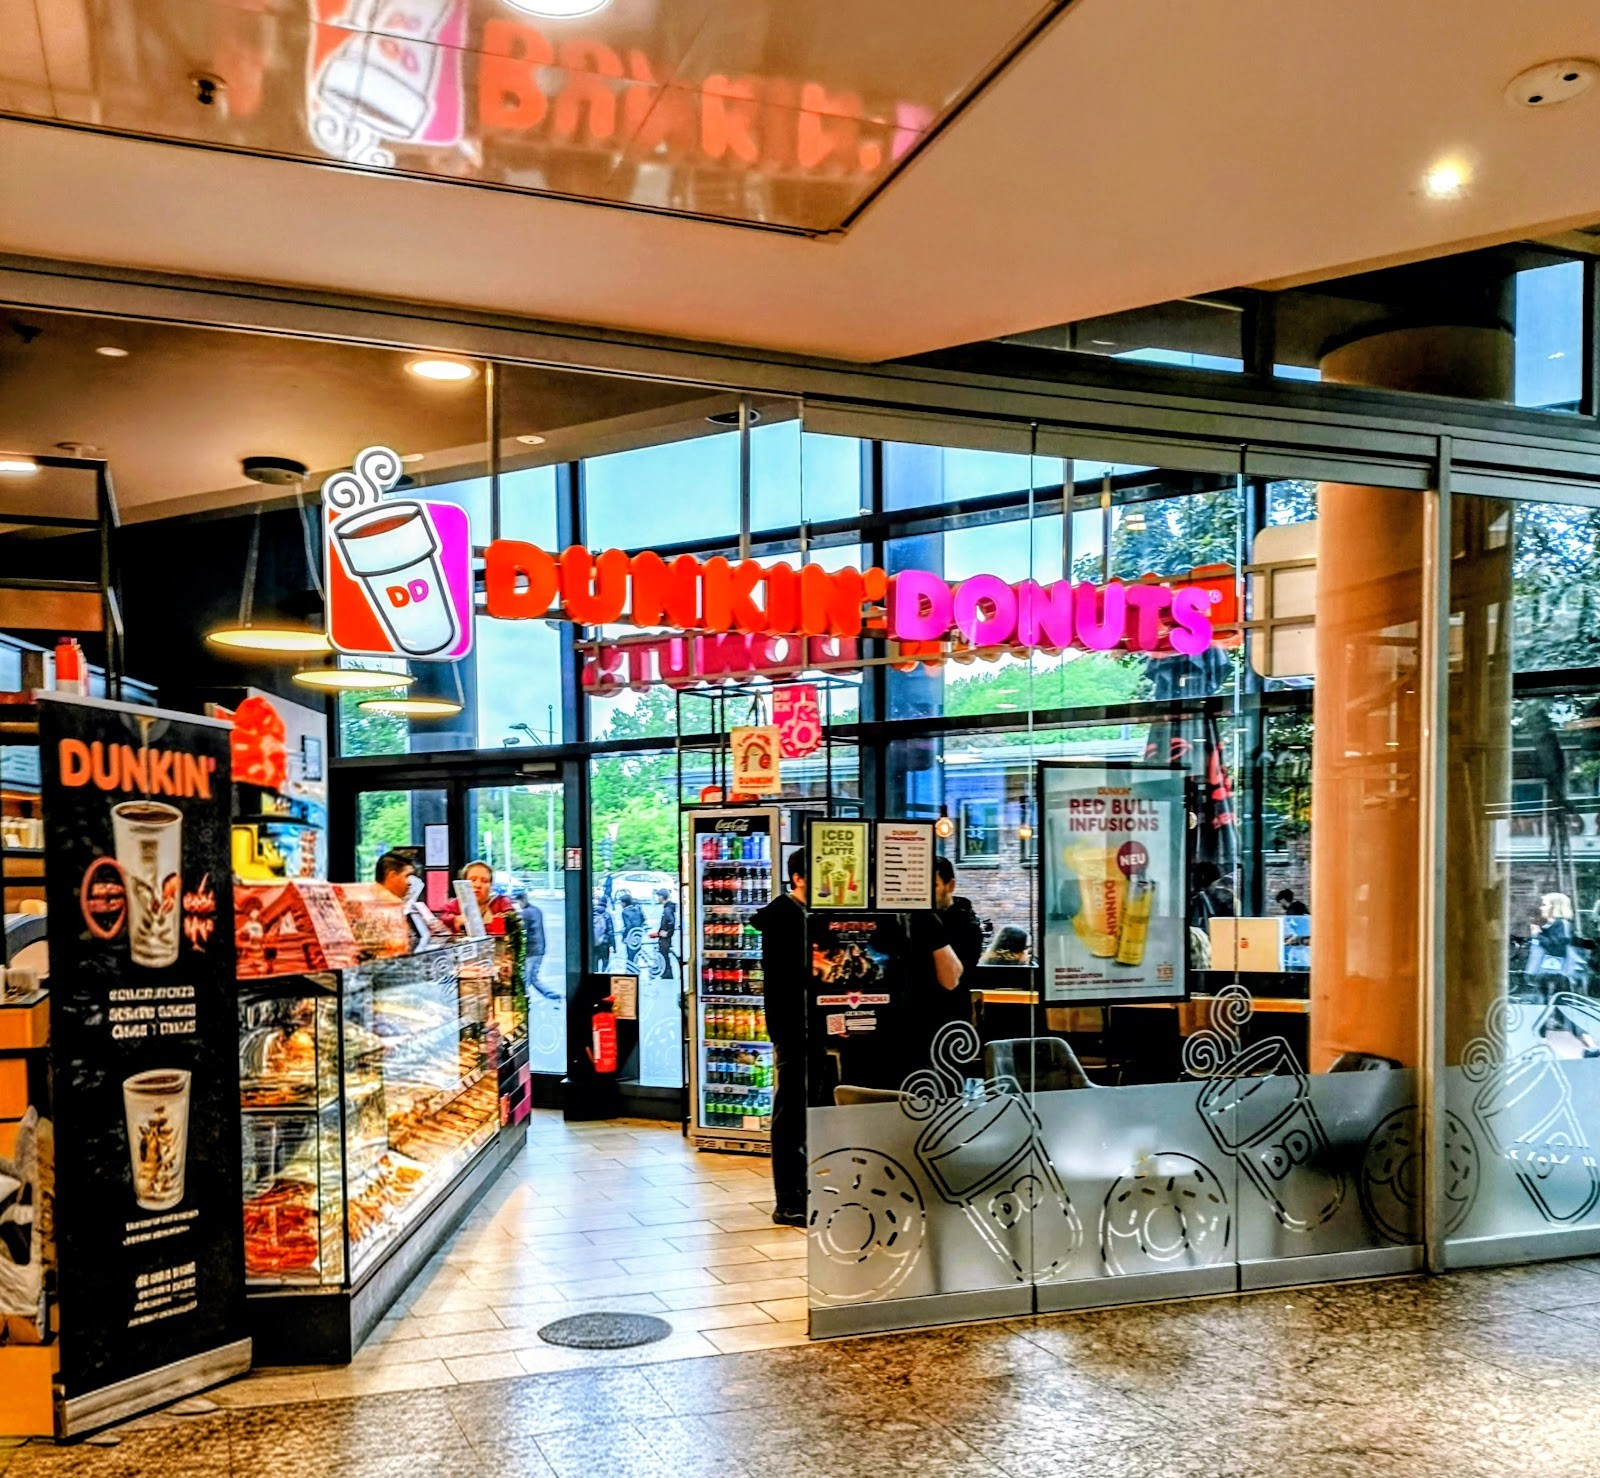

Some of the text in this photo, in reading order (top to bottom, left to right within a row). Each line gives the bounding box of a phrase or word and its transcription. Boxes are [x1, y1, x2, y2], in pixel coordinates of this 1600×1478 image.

[386, 578, 429, 608] DD
[484, 538, 1215, 655] DUNKIN' DONUTS
[59, 738, 217, 800] DUNKIN'
[1069, 798, 1159, 815] RED BULL
[1069, 817, 1159, 832] INFUSIONS
[822, 829, 854, 841] ICED
[822, 847, 855, 856] LATTE
[1119, 853, 1146, 867] NEU
[1260, 1129, 1311, 1180] DD
